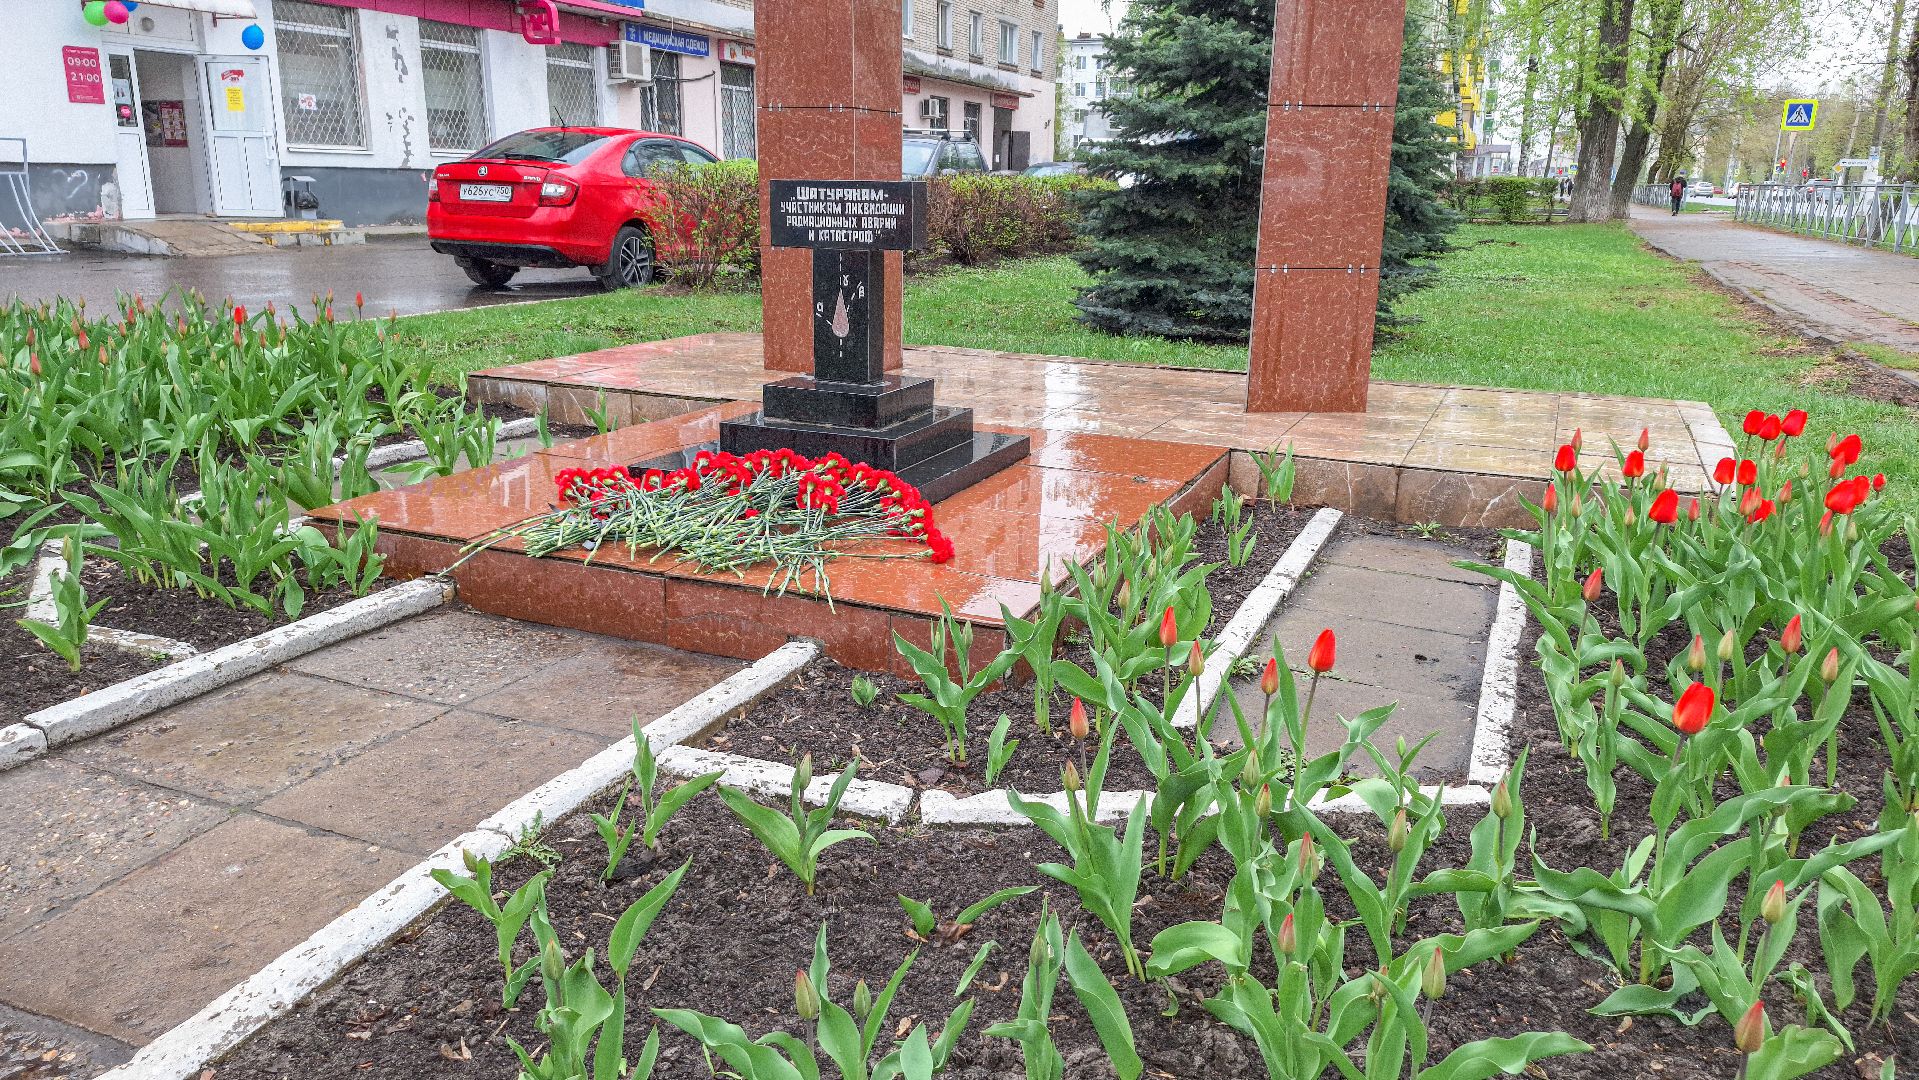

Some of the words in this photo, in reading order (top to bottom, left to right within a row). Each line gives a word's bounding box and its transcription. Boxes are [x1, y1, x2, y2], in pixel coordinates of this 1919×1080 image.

[685, 38, 708, 53] ОДЕЖДА
[67, 57, 97, 68] 09:00
[70, 71, 100, 83] 21:00
[780, 201, 842, 215] УЧАСТНИКАМ
[845, 202, 905, 216] ЛИКВИДАЦИИ
[786, 215, 858, 229] РАДИАЦИОННЫХ
[861, 216, 897, 230] АВАРИЙ
[808, 229, 815, 242] И
